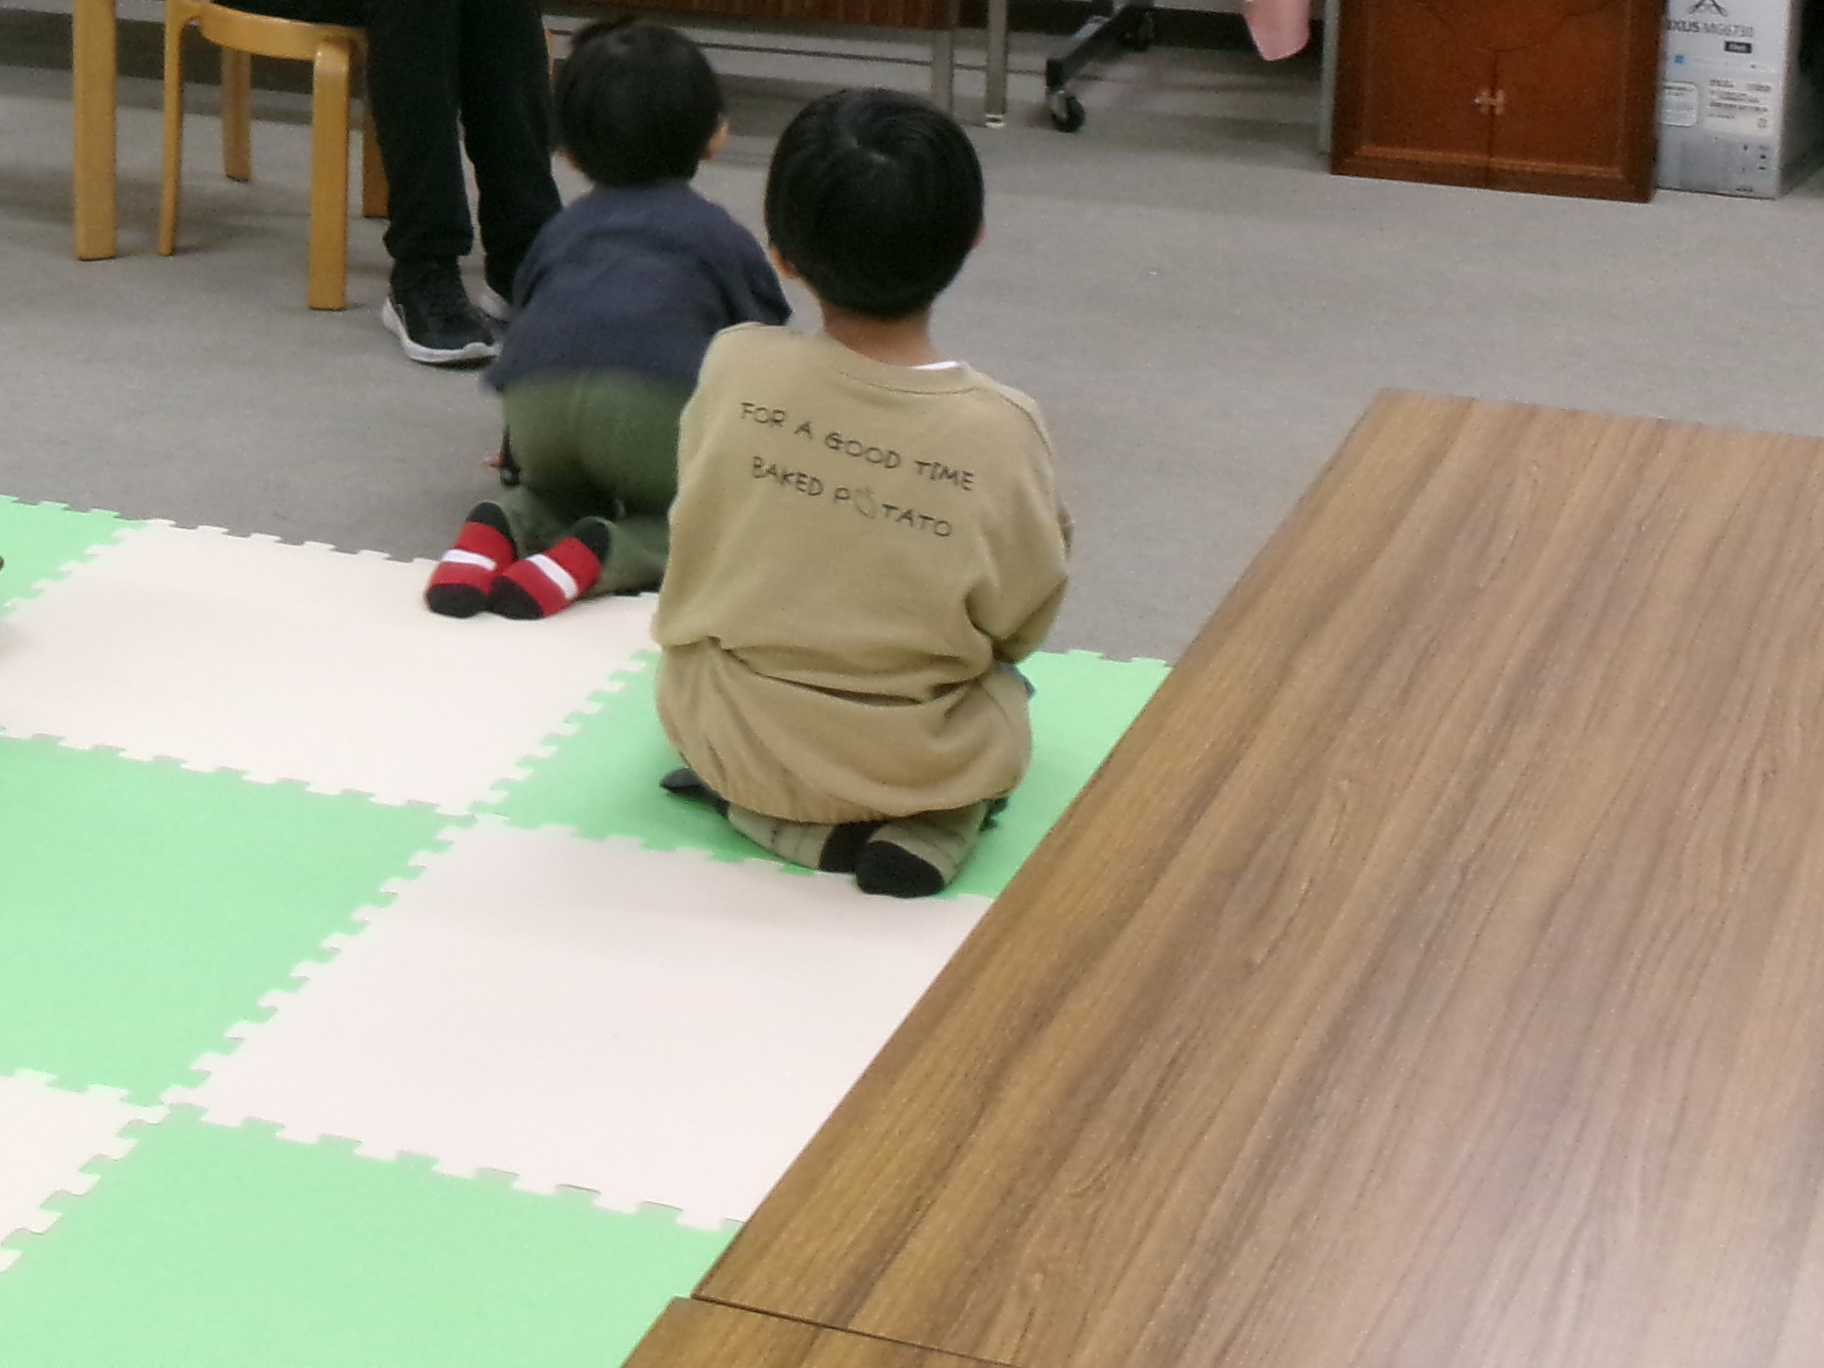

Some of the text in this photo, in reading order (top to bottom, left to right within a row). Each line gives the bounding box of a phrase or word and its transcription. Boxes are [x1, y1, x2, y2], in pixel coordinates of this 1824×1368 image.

[740, 402, 974, 491] FOR A GOOD TIME
[752, 456, 824, 497] BAKED
